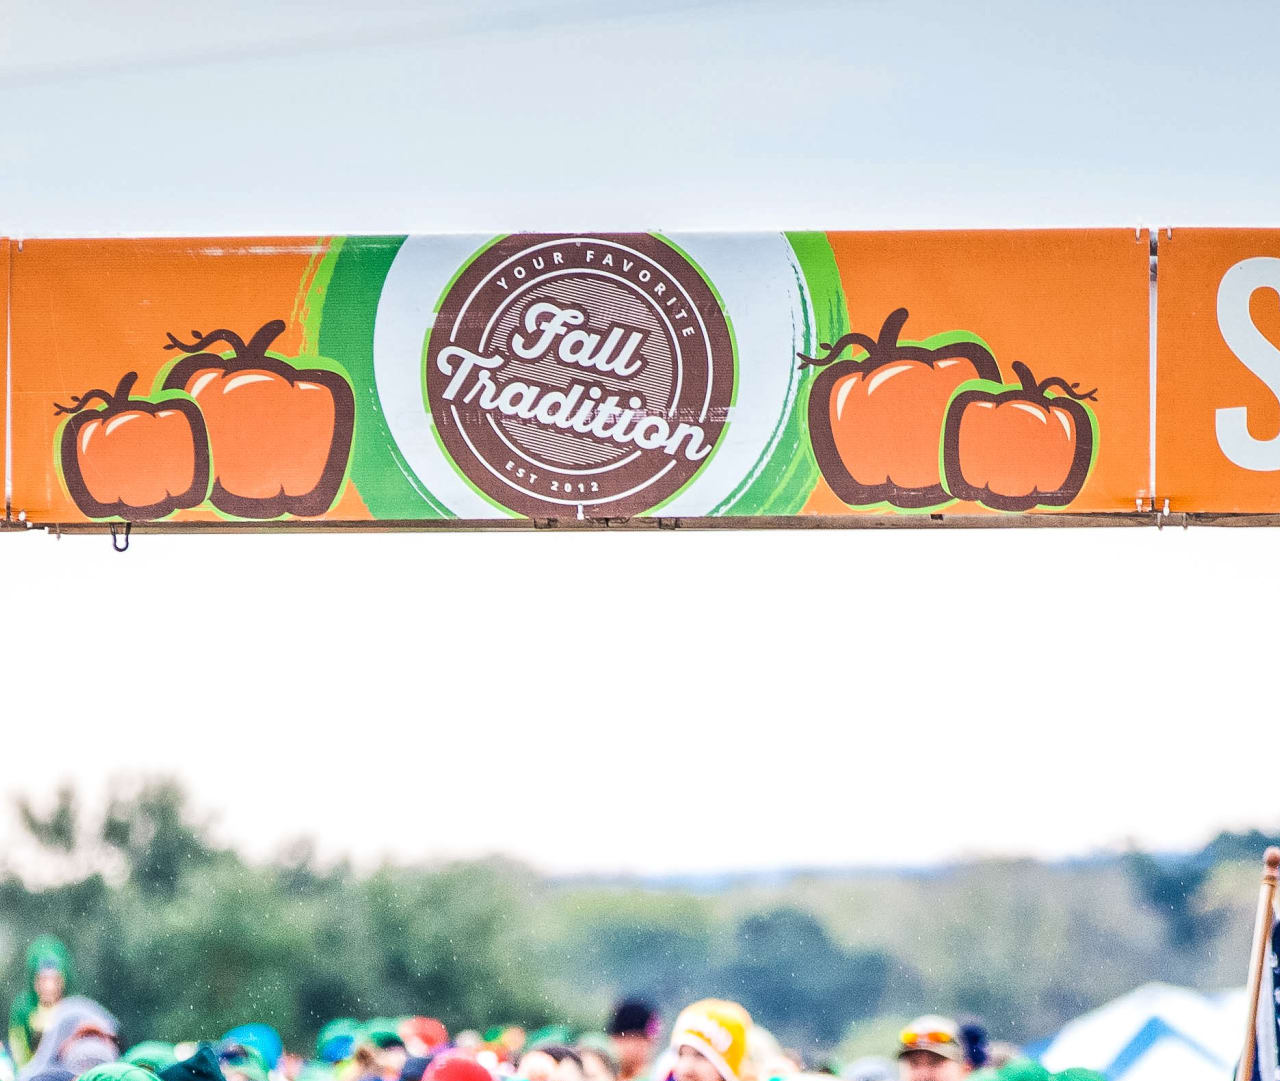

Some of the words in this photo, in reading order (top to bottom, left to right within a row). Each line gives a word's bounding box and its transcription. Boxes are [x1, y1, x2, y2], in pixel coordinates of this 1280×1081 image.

[496, 252, 565, 290] YOUR
[586, 250, 695, 338] FAVORITE
[512, 302, 644, 376] Fall
[436, 345, 712, 461] Tradition
[505, 460, 537, 484] EST
[551, 481, 600, 493] 2012
